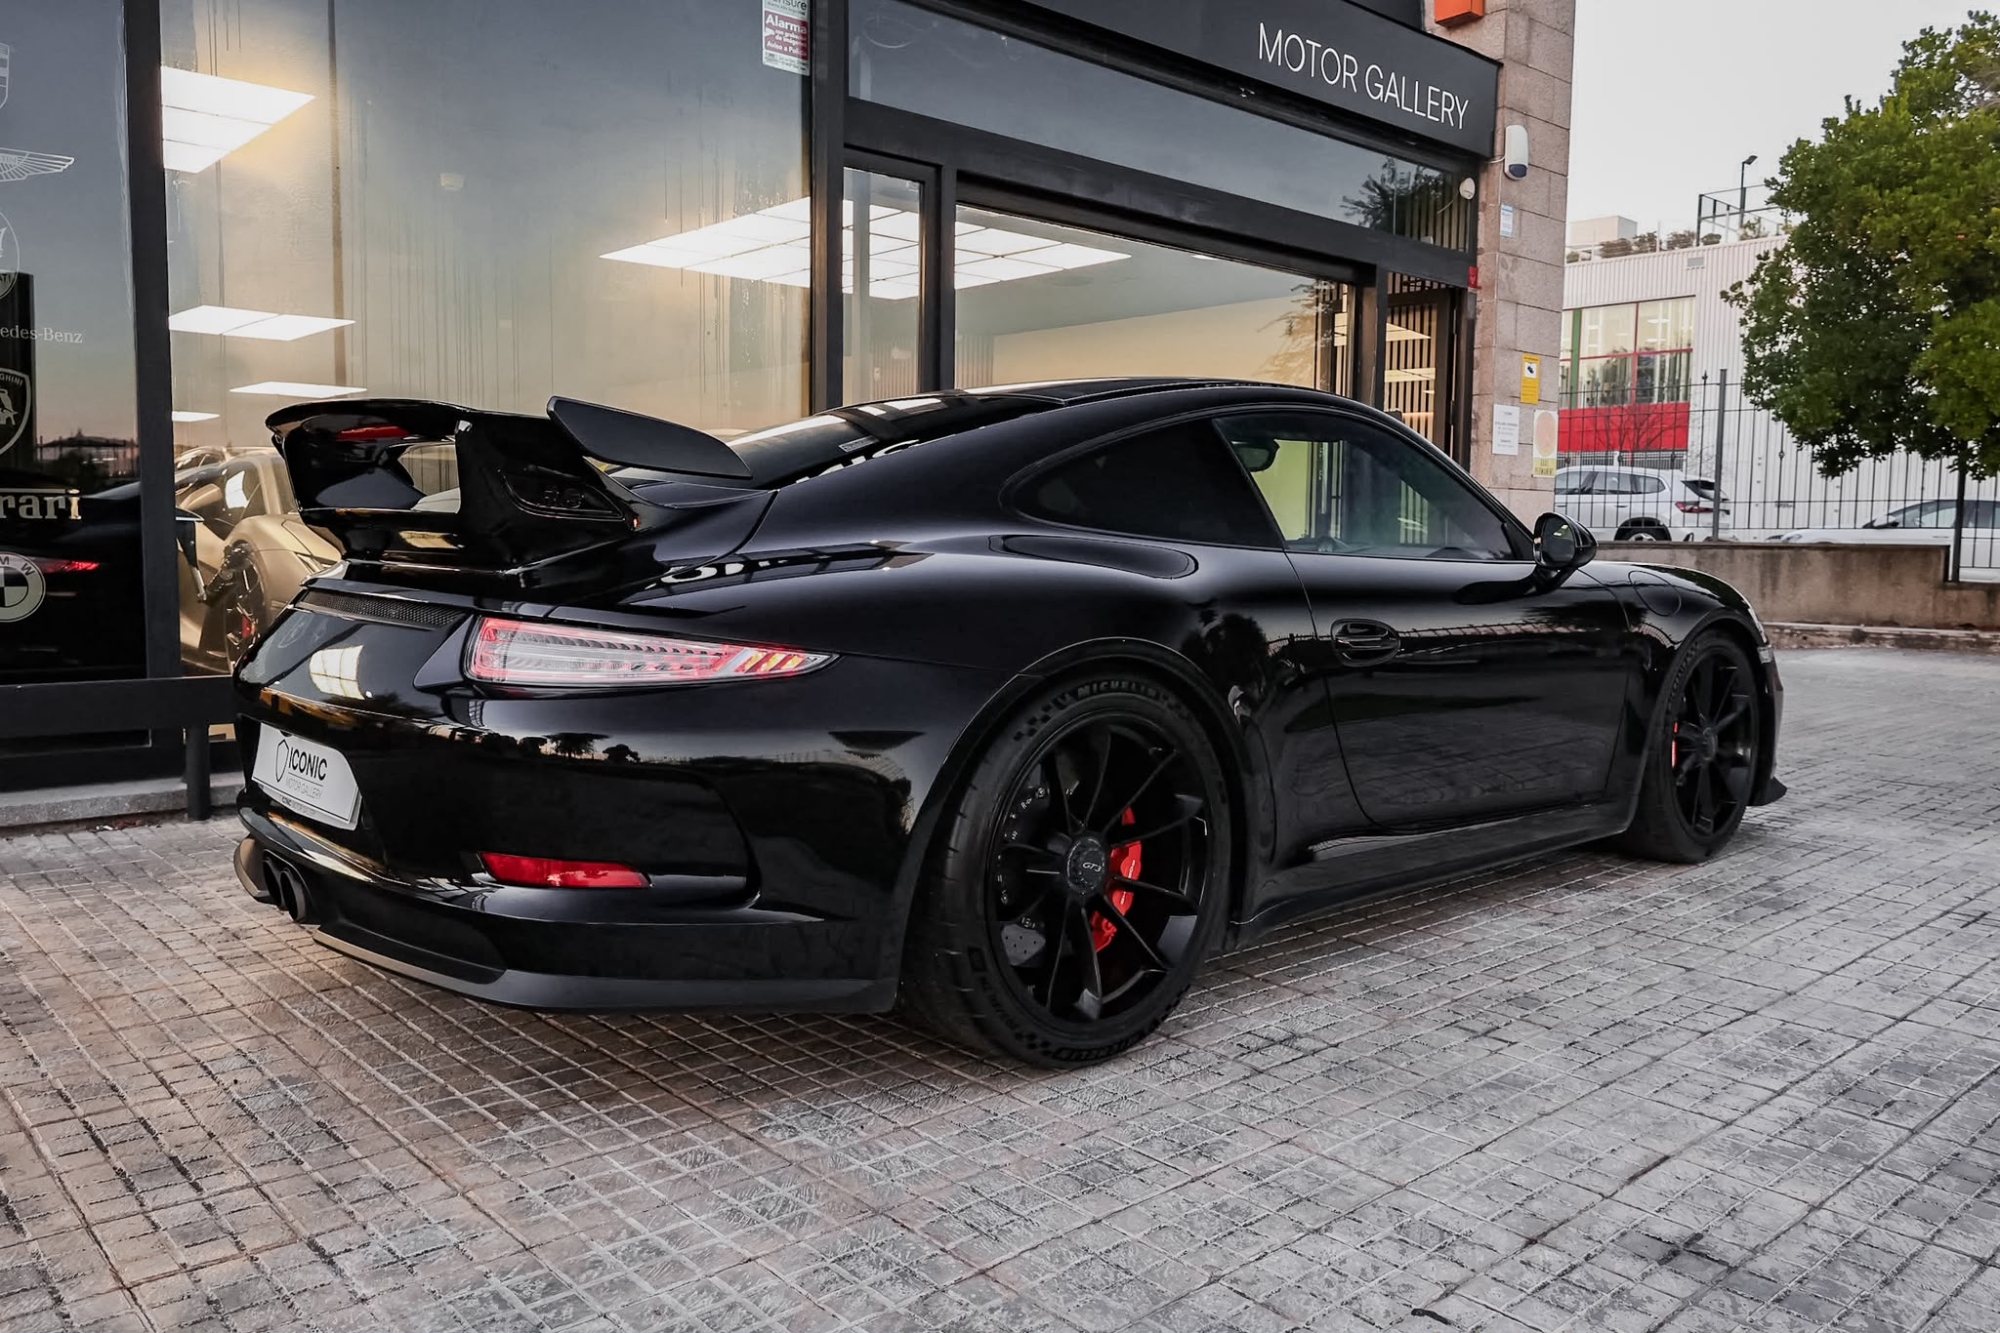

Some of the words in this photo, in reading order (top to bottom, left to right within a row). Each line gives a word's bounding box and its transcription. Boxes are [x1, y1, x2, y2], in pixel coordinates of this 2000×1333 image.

[766, 14, 807, 33] Alarma
[1259, 22, 1358, 93] MOTOR
[1365, 64, 1469, 129] GALLERY
[288, 747, 327, 781] ICONIC
[1082, 861, 1102, 872] GT3
